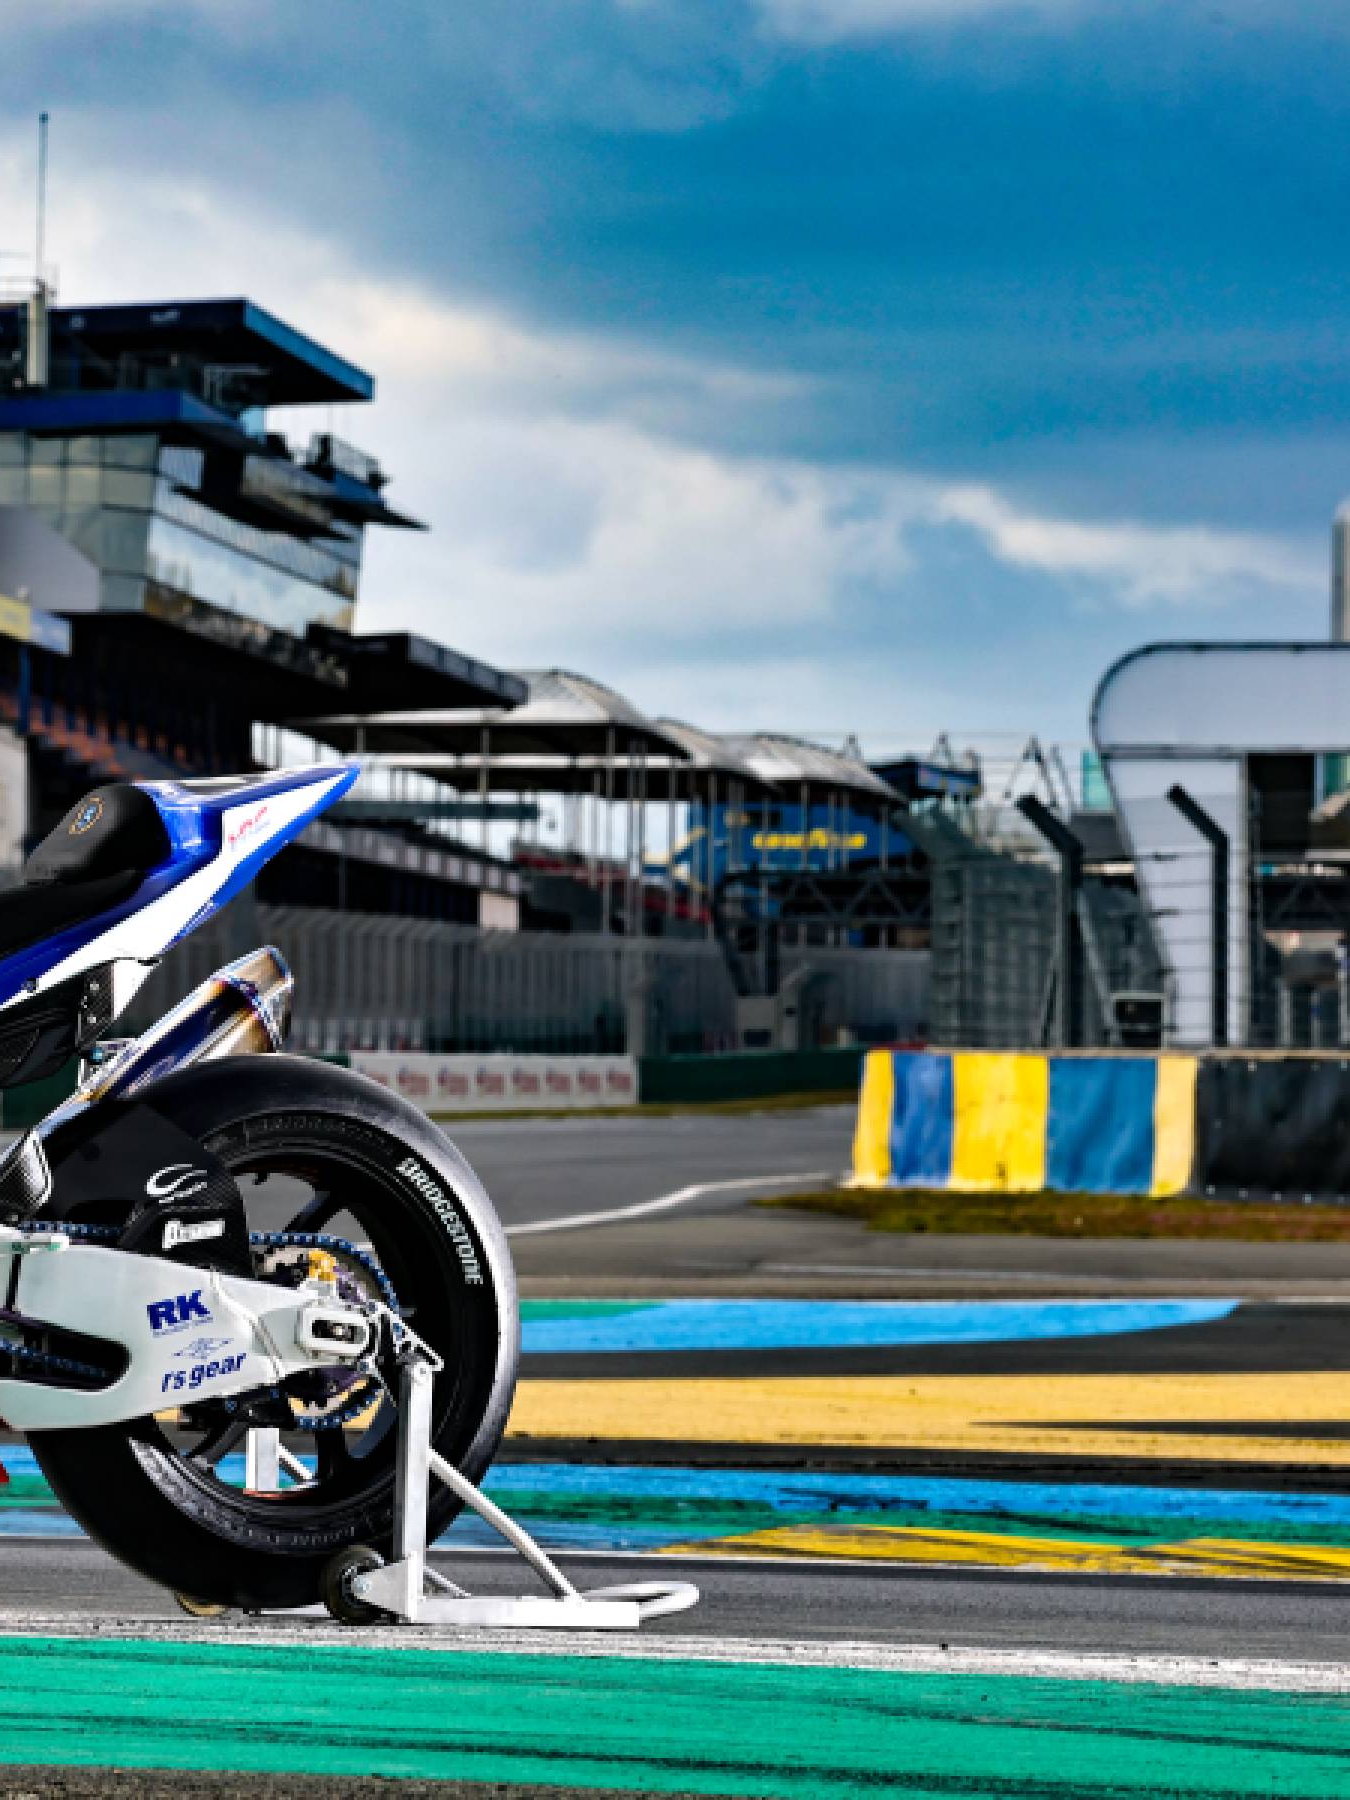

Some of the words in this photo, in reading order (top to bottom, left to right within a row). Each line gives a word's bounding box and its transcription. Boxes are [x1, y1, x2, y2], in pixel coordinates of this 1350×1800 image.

[396, 1158, 484, 1285] BRIDGESTONE
[147, 1289, 210, 1330] RK
[188, 1352, 247, 1390] gear
